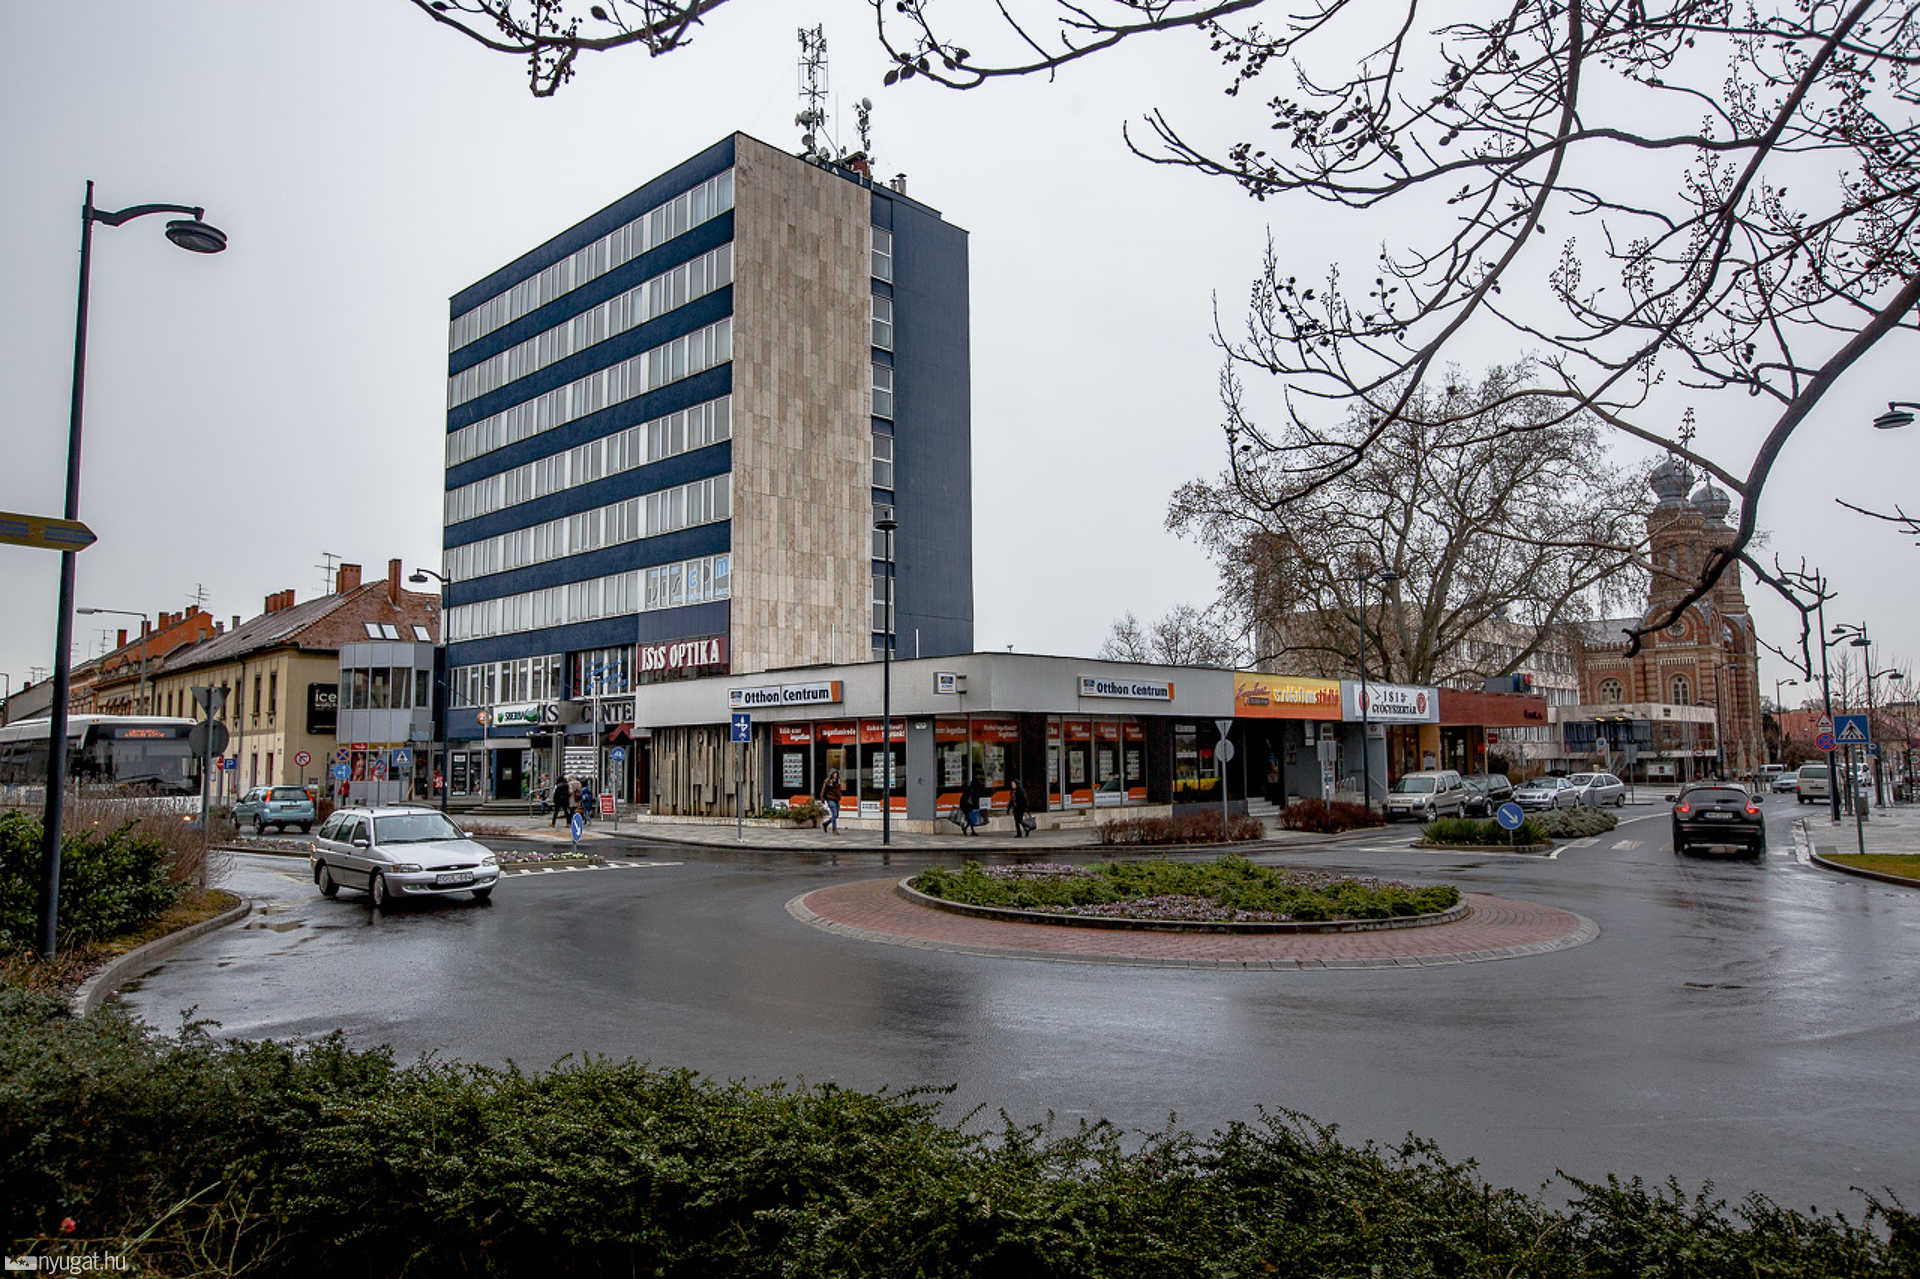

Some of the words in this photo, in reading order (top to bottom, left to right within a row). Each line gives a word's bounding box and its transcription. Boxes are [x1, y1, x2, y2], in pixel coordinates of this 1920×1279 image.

[641, 646, 667, 671] ISIS
[669, 638, 720, 668] OPTIKA
[744, 690, 779, 704] Otthon
[783, 688, 830, 702] Centrum
[1097, 682, 1129, 696] Otthon
[1132, 685, 1168, 697] Centrum
[226, 759, 234, 769] P
